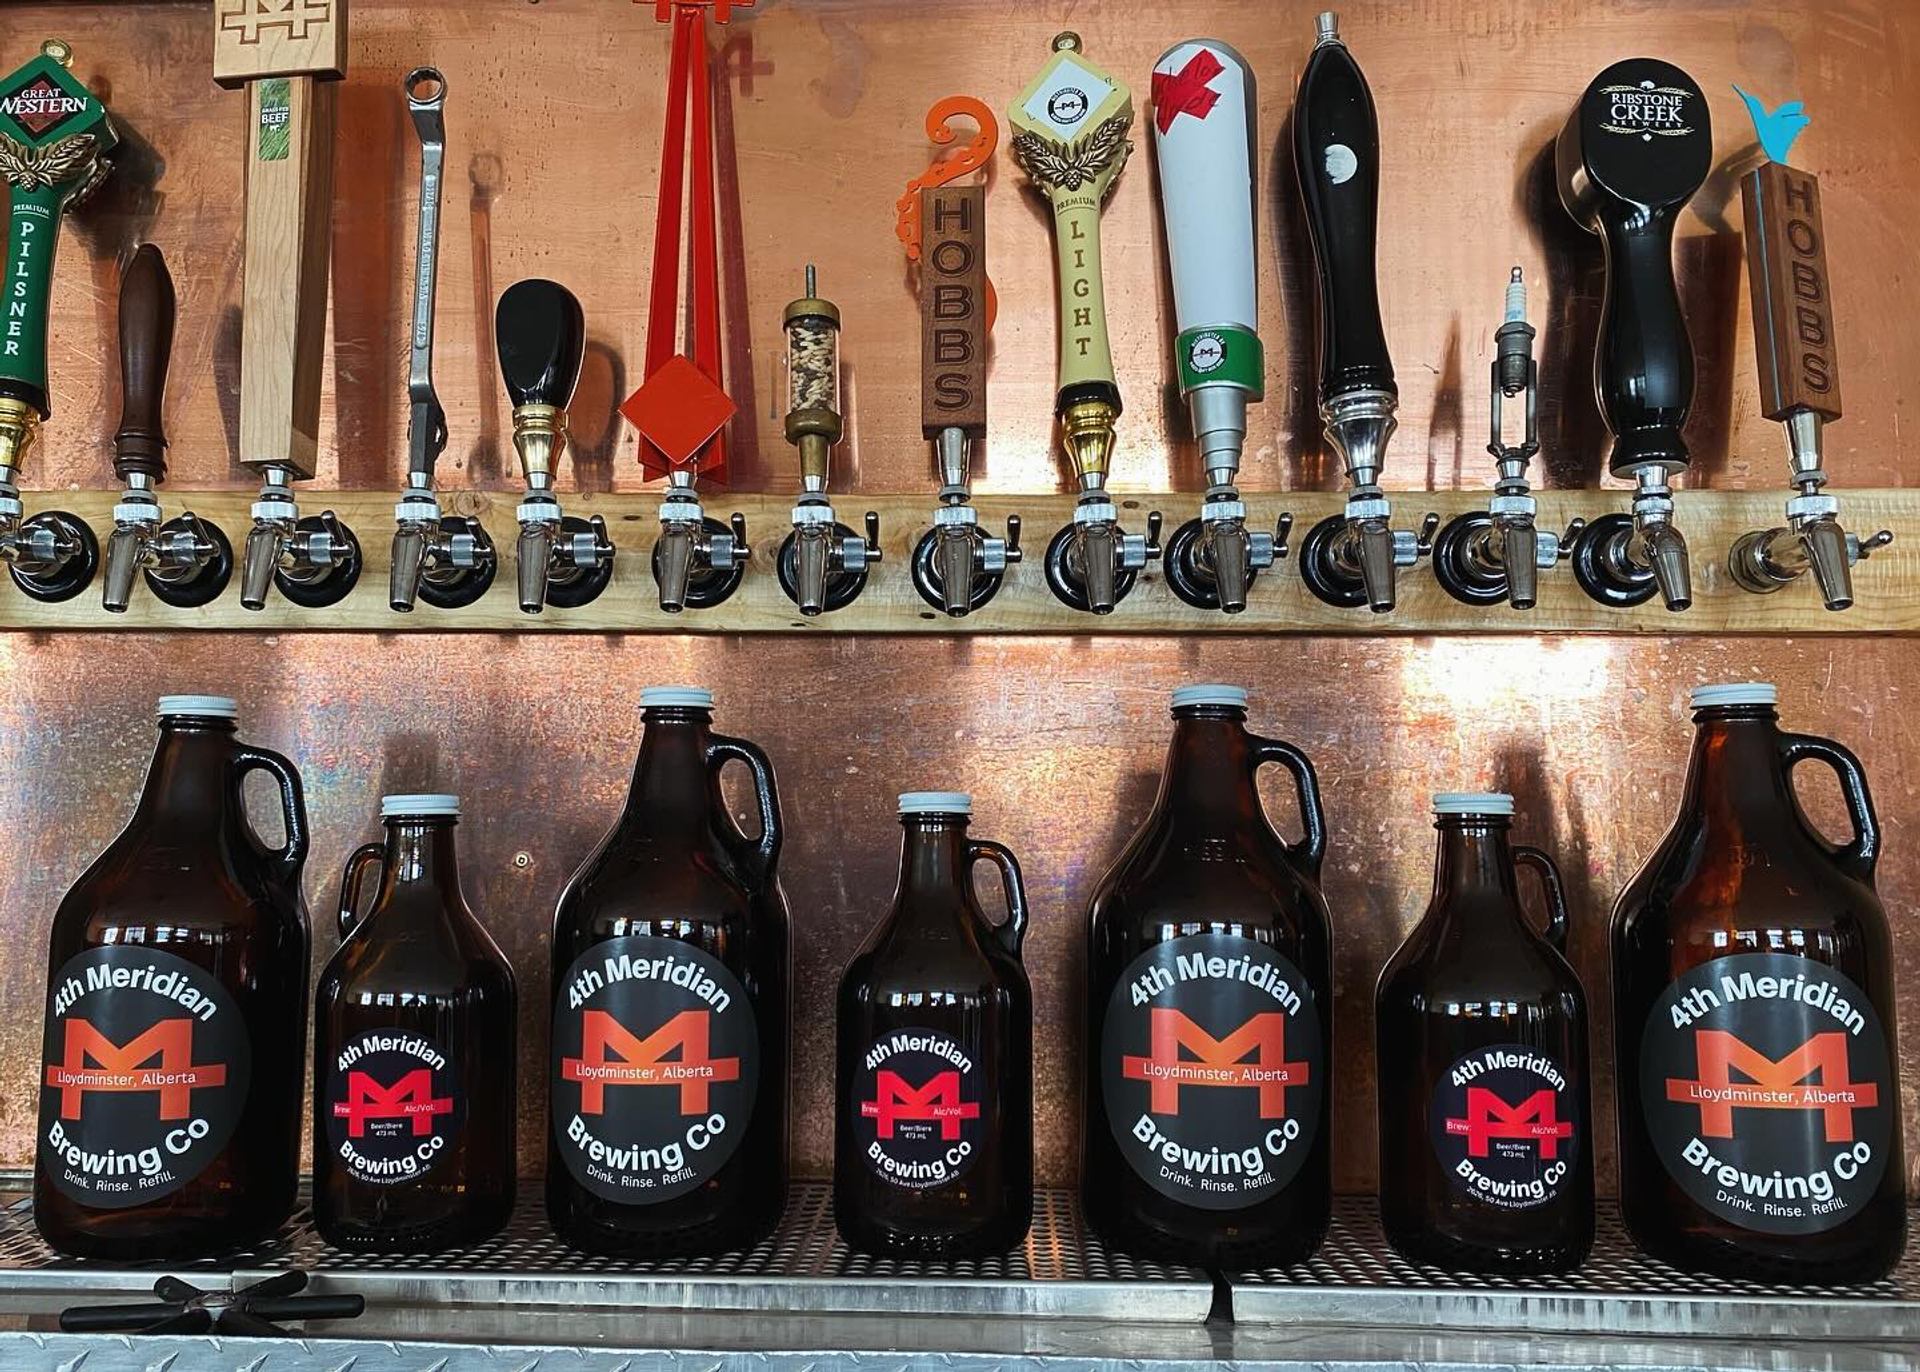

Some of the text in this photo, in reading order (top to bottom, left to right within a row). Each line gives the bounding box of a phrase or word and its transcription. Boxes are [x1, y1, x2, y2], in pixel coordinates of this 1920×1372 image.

[0, 96, 88, 115] WESTERN
[21, 88, 61, 99] GREAT
[1611, 93, 1683, 107] RIBSTONE
[261, 112, 289, 124] BEEF
[1610, 104, 1684, 122] CREEK
[1612, 120, 1683, 128] BREWERY
[13, 203, 50, 215] PREMIUM
[1056, 196, 1097, 211] PREMIUM
[5, 221, 36, 357] PILSNER
[1070, 220, 1092, 357] LIGHT
[1784, 172, 1832, 396] HOBBS
[931, 198, 976, 412] HOBBS
[54, 963, 218, 1022] 4th Meridian
[568, 954, 731, 1014] 4th Meridian
[1130, 952, 1302, 1017] 4th Meridian
[1669, 972, 1866, 1036] 4th Meridian
[338, 1034, 446, 1072] 4th Meridian
[865, 1034, 973, 1074] 4th Meridian
[1451, 1051, 1567, 1092] 4th Meridian
[57, 1071, 196, 1088] Lloydminster, Alberta
[576, 1064, 714, 1082] Lloydminster, Alberta
[1143, 1062, 1289, 1084] Lloydminster, Alberta
[1690, 1084, 1856, 1106] Lloydminster, Alberta
[48, 1118, 210, 1176] Brewing Co
[340, 1135, 444, 1174] Brewing Co
[566, 1112, 726, 1173] Brewing Co
[867, 1141, 972, 1179] Brewing Co
[1132, 1113, 1300, 1176] Brewing Co
[63, 1169, 176, 1192] Drink. Rinse. Refill.
[586, 1164, 697, 1188] Drink. Rinse. Refill.
[1159, 1165, 1276, 1192] Drink. Rinse. Refill.
[1455, 1158, 1567, 1199] Brewing Co
[1681, 1137, 1872, 1202] Brewing Co
[1716, 1189, 1848, 1217] Drink. Rinse. Refill.
